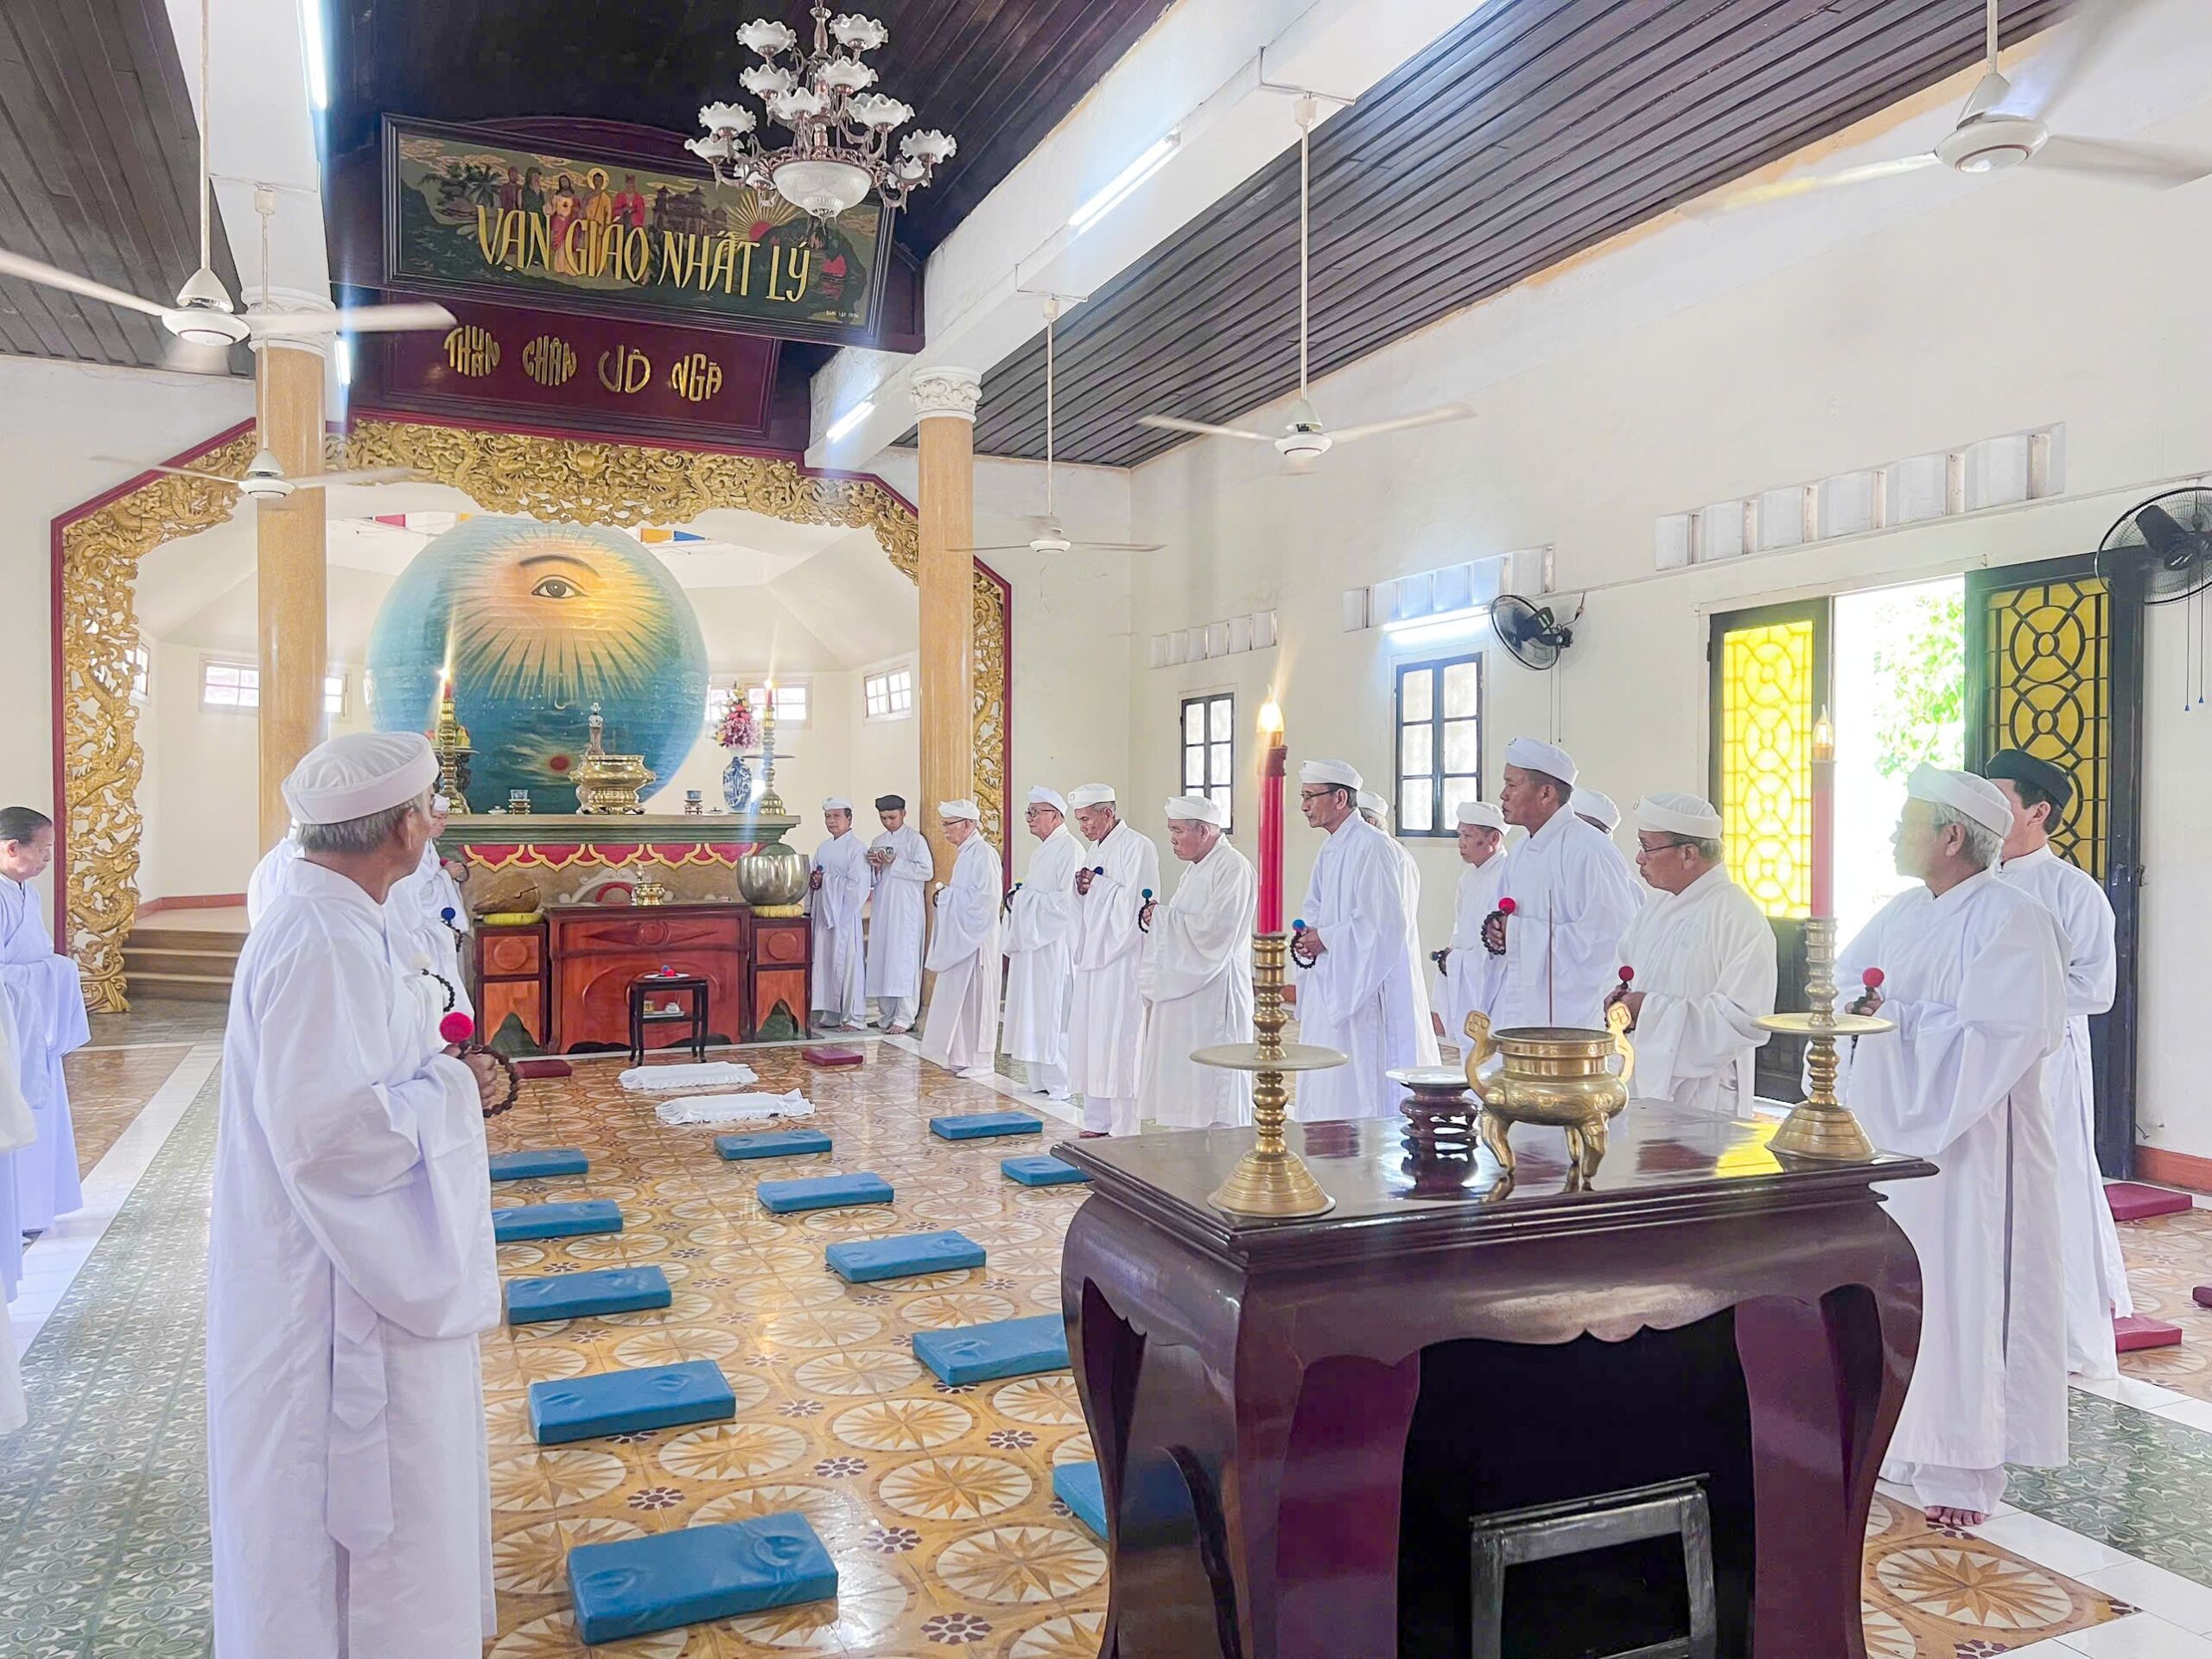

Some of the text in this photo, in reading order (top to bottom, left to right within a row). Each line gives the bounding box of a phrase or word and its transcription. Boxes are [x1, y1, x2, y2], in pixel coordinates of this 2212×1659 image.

[476, 204, 810, 303] VẠN GIÁO NHẤT LÝ
[522, 335, 577, 386] CHÂN
[598, 345, 651, 394] VÔ
